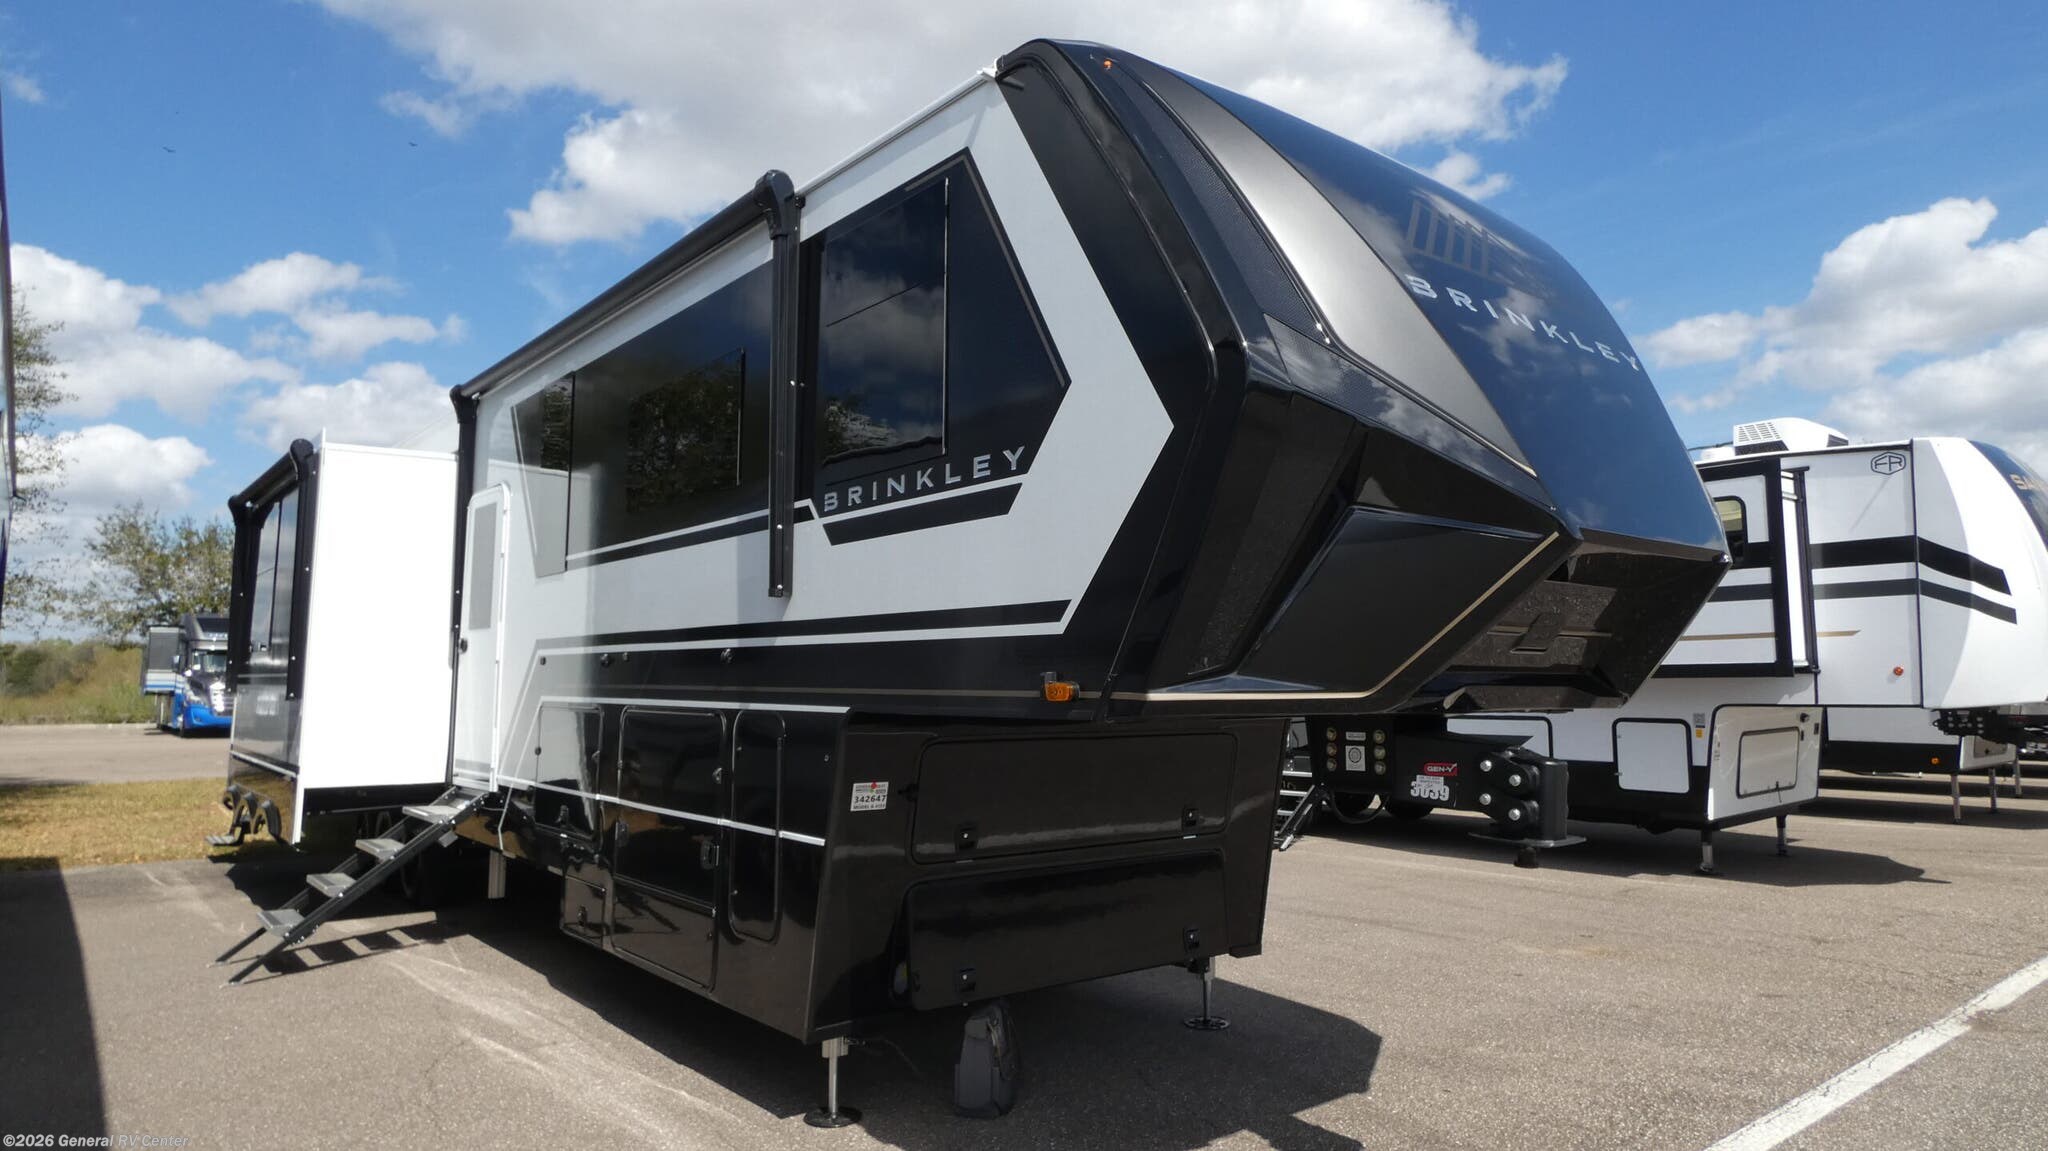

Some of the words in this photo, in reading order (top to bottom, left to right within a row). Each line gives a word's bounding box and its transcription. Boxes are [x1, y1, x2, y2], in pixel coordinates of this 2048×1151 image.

[1404, 273, 1640, 372] BRINKLEY
[823, 445, 1025, 512] BRINKLEY
[1426, 763, 1457, 773] GEN-Y
[855, 795, 887, 803] 342647
